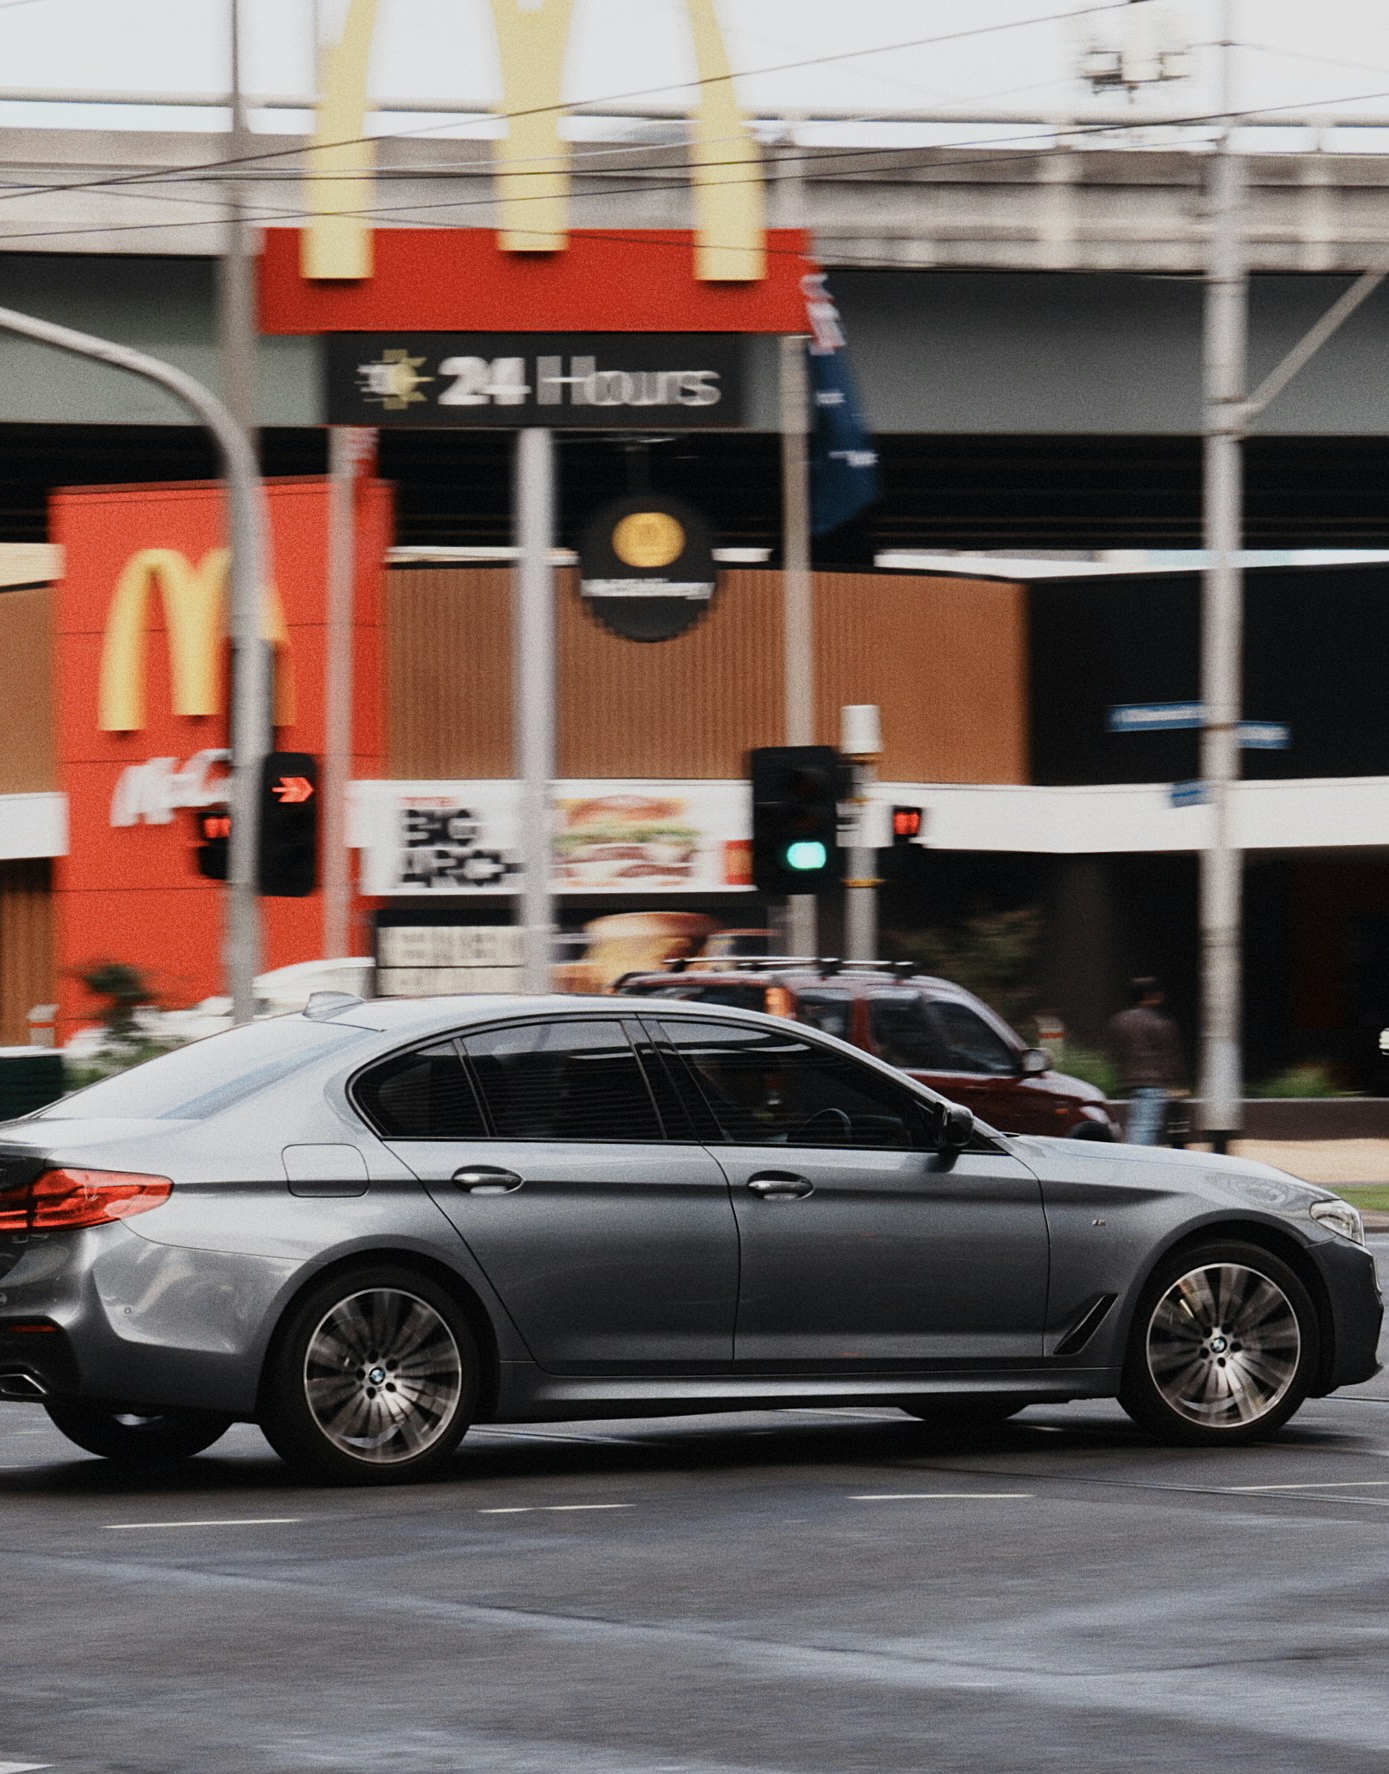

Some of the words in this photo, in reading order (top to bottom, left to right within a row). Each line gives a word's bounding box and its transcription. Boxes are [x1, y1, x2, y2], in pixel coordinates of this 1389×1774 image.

[438, 356, 531, 405] 24
[537, 355, 722, 406] Hours
[110, 748, 233, 828] McC
